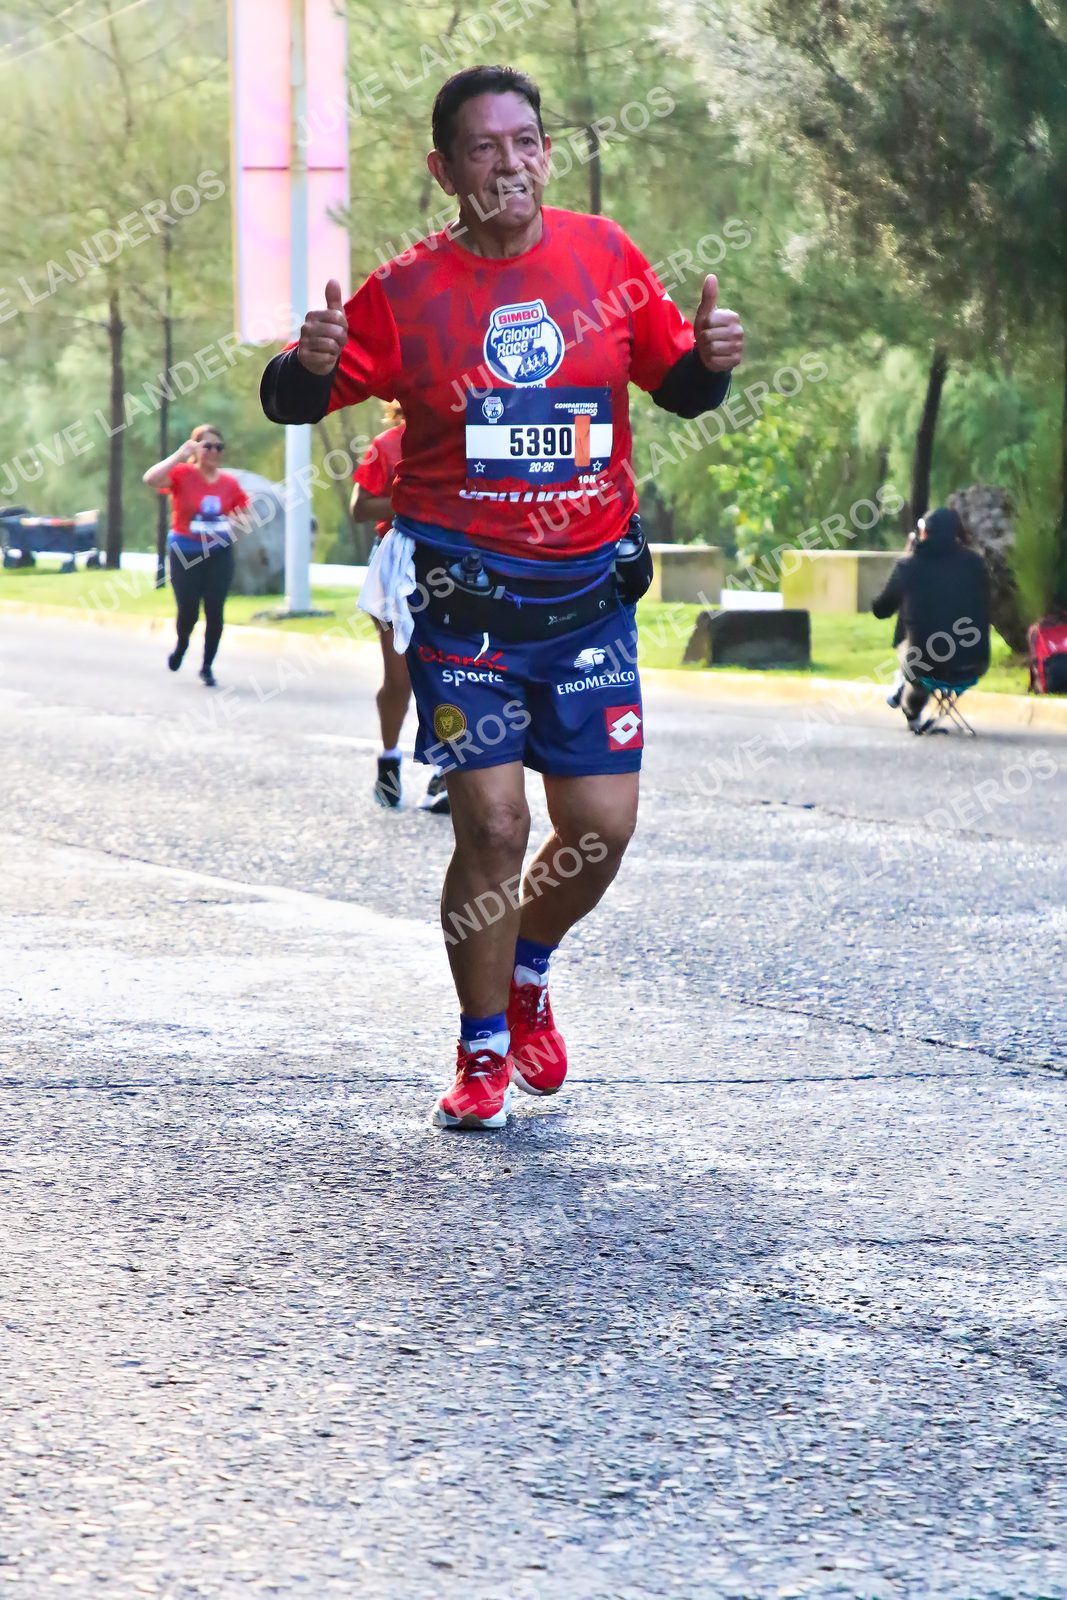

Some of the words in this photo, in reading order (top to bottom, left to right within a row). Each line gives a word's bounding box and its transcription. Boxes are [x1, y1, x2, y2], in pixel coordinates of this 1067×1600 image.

[498, 309, 540, 325] BIMBO
[502, 323, 542, 344] Global
[496, 340, 529, 358] Race
[510, 427, 572, 456] 5390
[578, 474, 597, 484] 10K
